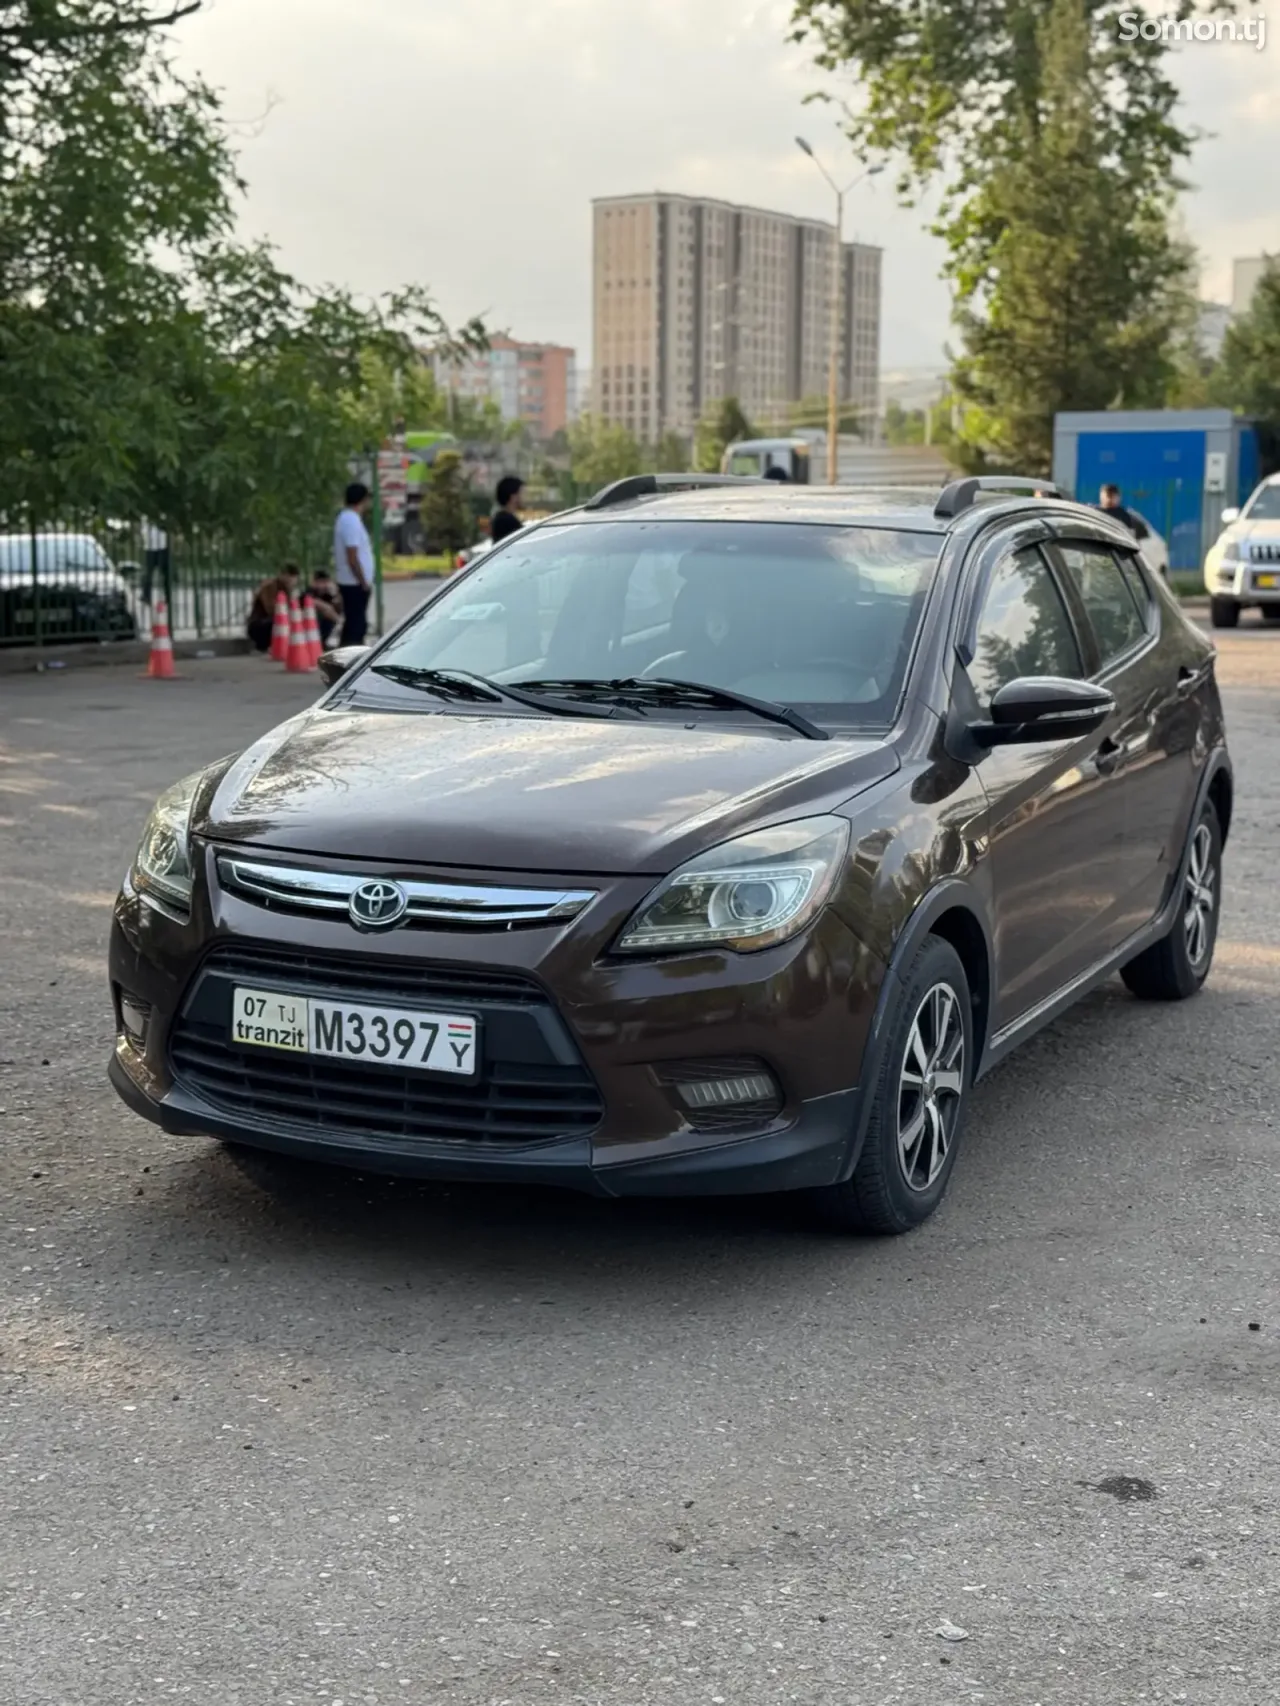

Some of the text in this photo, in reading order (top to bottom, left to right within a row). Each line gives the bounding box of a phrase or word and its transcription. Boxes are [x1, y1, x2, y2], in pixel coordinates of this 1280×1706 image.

[244, 996, 296, 1024] 07 TJ
[236, 1019, 305, 1048] tranzit
[314, 1008, 440, 1063] M3397
[449, 1041, 471, 1068] Y
